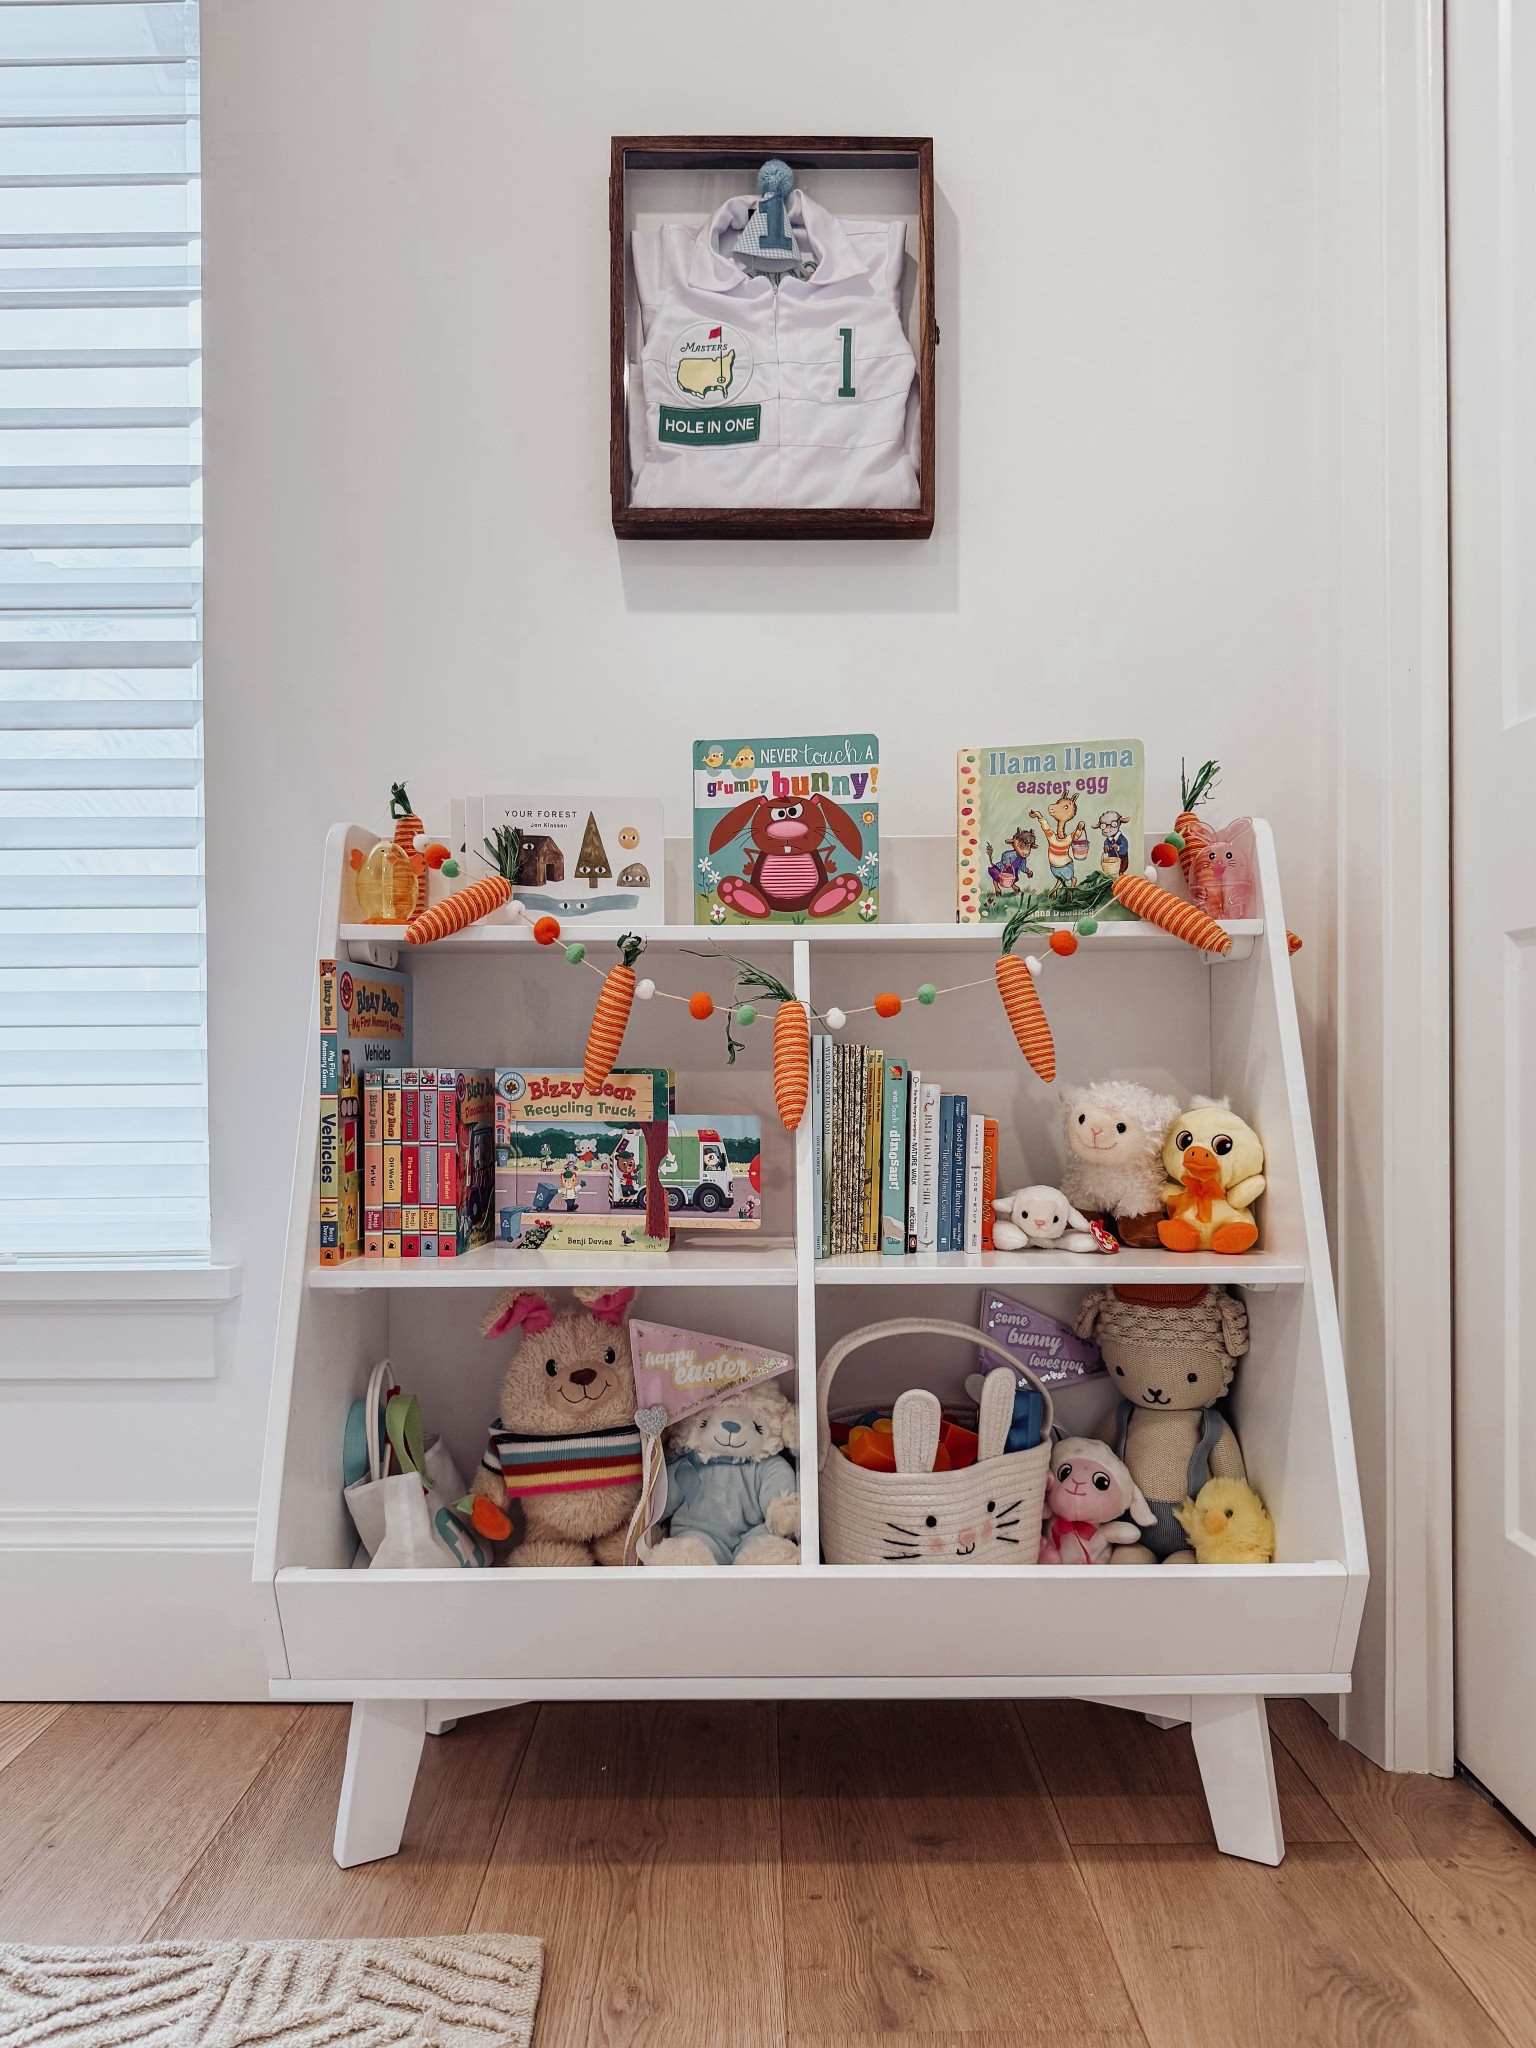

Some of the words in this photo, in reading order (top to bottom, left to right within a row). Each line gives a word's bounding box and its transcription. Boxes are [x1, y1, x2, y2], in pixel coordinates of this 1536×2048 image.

[758, 194, 792, 250] 1
[838, 328, 856, 397] 1
[665, 418, 704, 434] HOLE
[707, 420, 721, 433] IN
[725, 418, 755, 432] ONE
[760, 748, 798, 764] NEVER
[798, 739, 863, 765] touch
[865, 745, 874, 760] A
[989, 752, 1056, 776] llama
[1064, 747, 1134, 771] llama
[706, 778, 769, 798] grumpy
[772, 767, 879, 800] bunny!
[1016, 780, 1071, 795] easter
[1075, 776, 1109, 795] egg
[504, 810, 533, 818] YOUR
[538, 810, 578, 818] FOREST
[324, 980, 332, 1004] Bizzy
[356, 985, 380, 1015] Bizzy
[382, 988, 400, 1018] Bear
[324, 1005, 332, 1026] Bear
[352, 1018, 360, 1032] My
[360, 1016, 371, 1028] First
[372, 1016, 390, 1031] Memory
[328, 1050, 336, 1062] My
[364, 1044, 391, 1062] Vehicles
[528, 1076, 584, 1100] Bizzy
[369, 1094, 378, 1118] Bizzy
[388, 1092, 396, 1116] Bizzy
[406, 1094, 414, 1117] Bizzy
[424, 1094, 432, 1117] Bizzy
[443, 1095, 452, 1118] Bizzy
[524, 1101, 592, 1118] Recycling
[596, 1102, 636, 1118] Truck
[369, 1119, 378, 1139] Bear
[388, 1117, 396, 1138] Bear
[406, 1118, 414, 1138] Bear
[424, 1118, 432, 1138] Bear
[443, 1119, 452, 1140] Bear
[956, 1123, 964, 1142] Good
[322, 1113, 336, 1183] Vehicles
[942, 1148, 950, 1160] The
[955, 1144, 963, 1164] Night
[888, 1130, 900, 1190] dinosaur!
[983, 1146, 993, 1194] GOODNIGHT
[388, 1168, 394, 1178] We
[982, 1198, 990, 1224] MOON
[568, 1236, 586, 1246] Benji
[588, 1237, 612, 1246] Davies
[994, 1312, 1028, 1326] some
[1008, 1328, 1062, 1356] bunny
[645, 1350, 696, 1370] happy
[674, 1354, 750, 1385] easter
[1028, 1352, 1060, 1369] loves
[1060, 1360, 1084, 1372] you
